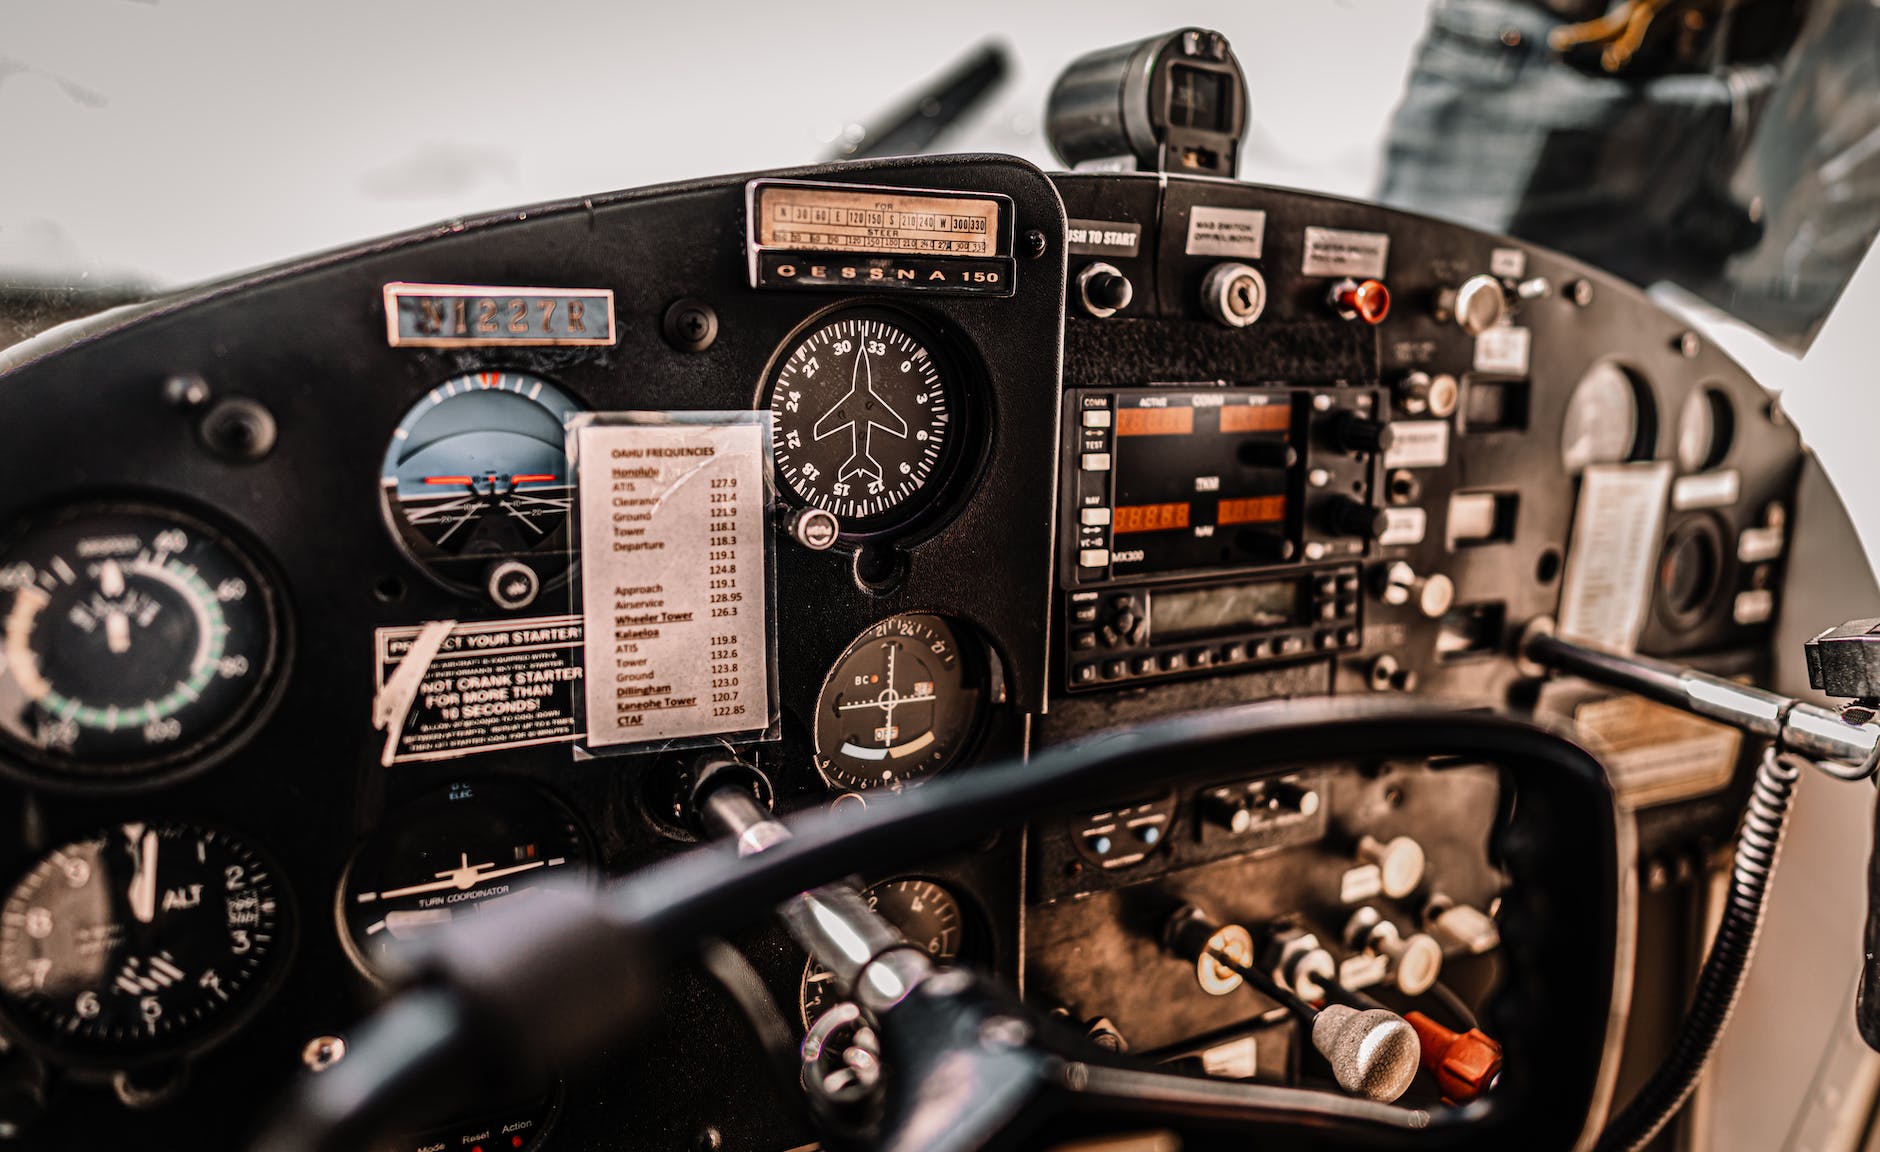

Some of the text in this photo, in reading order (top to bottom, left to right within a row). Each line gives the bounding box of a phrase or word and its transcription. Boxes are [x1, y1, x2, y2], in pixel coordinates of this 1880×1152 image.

[850, 212, 864, 224] 120
[868, 213, 882, 225] 150
[889, 214, 895, 225] S
[902, 216, 916, 227] 210
[920, 216, 934, 228] 240
[940, 218, 947, 229] W
[953, 219, 968, 230] 300
[970, 219, 985, 231] 330
[867, 228, 899, 237] STEER
[1088, 230, 1103, 244] TO
[1103, 231, 1137, 246] START
[776, 264, 999, 284] CESSNA 150
[833, 340, 852, 356] 30
[867, 340, 887, 356] 33
[802, 356, 820, 379] 27
[786, 390, 801, 413] 24
[1084, 398, 1107, 407] COMM
[786, 430, 801, 450] 21
[1085, 440, 1103, 450] TEST
[611, 446, 716, 459] OAHU FREQUENCIES
[802, 462, 820, 481] 18
[710, 479, 738, 488] 127.9
[833, 482, 851, 497] 15
[867, 479, 886, 495] 12
[710, 493, 737, 503] 121.4
[1085, 496, 1100, 505] NAV
[710, 508, 737, 518] 121.9
[613, 527, 645, 537] Tower
[710, 522, 736, 532] 118.1
[613, 541, 665, 553] Departure
[710, 536, 737, 547] 118.3
[709, 551, 736, 561] 119.1
[709, 565, 736, 575] 124.8
[709, 579, 736, 589] 119.1
[614, 584, 663, 598] Approach
[710, 593, 743, 603] 128.95
[614, 599, 664, 610] Airservice
[615, 611, 693, 626] Wheeler Tower
[711, 607, 738, 618] 126.3
[615, 627, 660, 640] Kalaeloa
[876, 624, 887, 637] 21
[900, 623, 914, 637] 24
[389, 626, 583, 653] PRCT YOUR STARTER!
[710, 635, 738, 646] 119.8
[616, 644, 638, 654] ATIS
[711, 649, 738, 660] 132.6
[616, 657, 648, 668] Tower
[711, 664, 739, 674] 123.8
[420, 678, 455, 695] NOT
[456, 673, 513, 692] CRANK
[514, 666, 584, 684] STARTER
[616, 670, 655, 682] Ground
[854, 675, 870, 686] BC
[711, 678, 739, 688] 123.0
[425, 682, 554, 710] FOR MORE THAN
[616, 684, 672, 697] Dillingham
[712, 692, 739, 702] 120.7
[441, 698, 541, 721] 10 SECONDS!
[617, 696, 697, 712] Kaneohe Tower
[712, 706, 745, 716] 122.85
[617, 715, 644, 727] CTAF
[224, 865, 246, 890] 2
[162, 884, 204, 912] ALT
[418, 885, 509, 908] TURN COORDINATOR
[501, 1120, 533, 1134] Action
[462, 1130, 490, 1144] Reset
